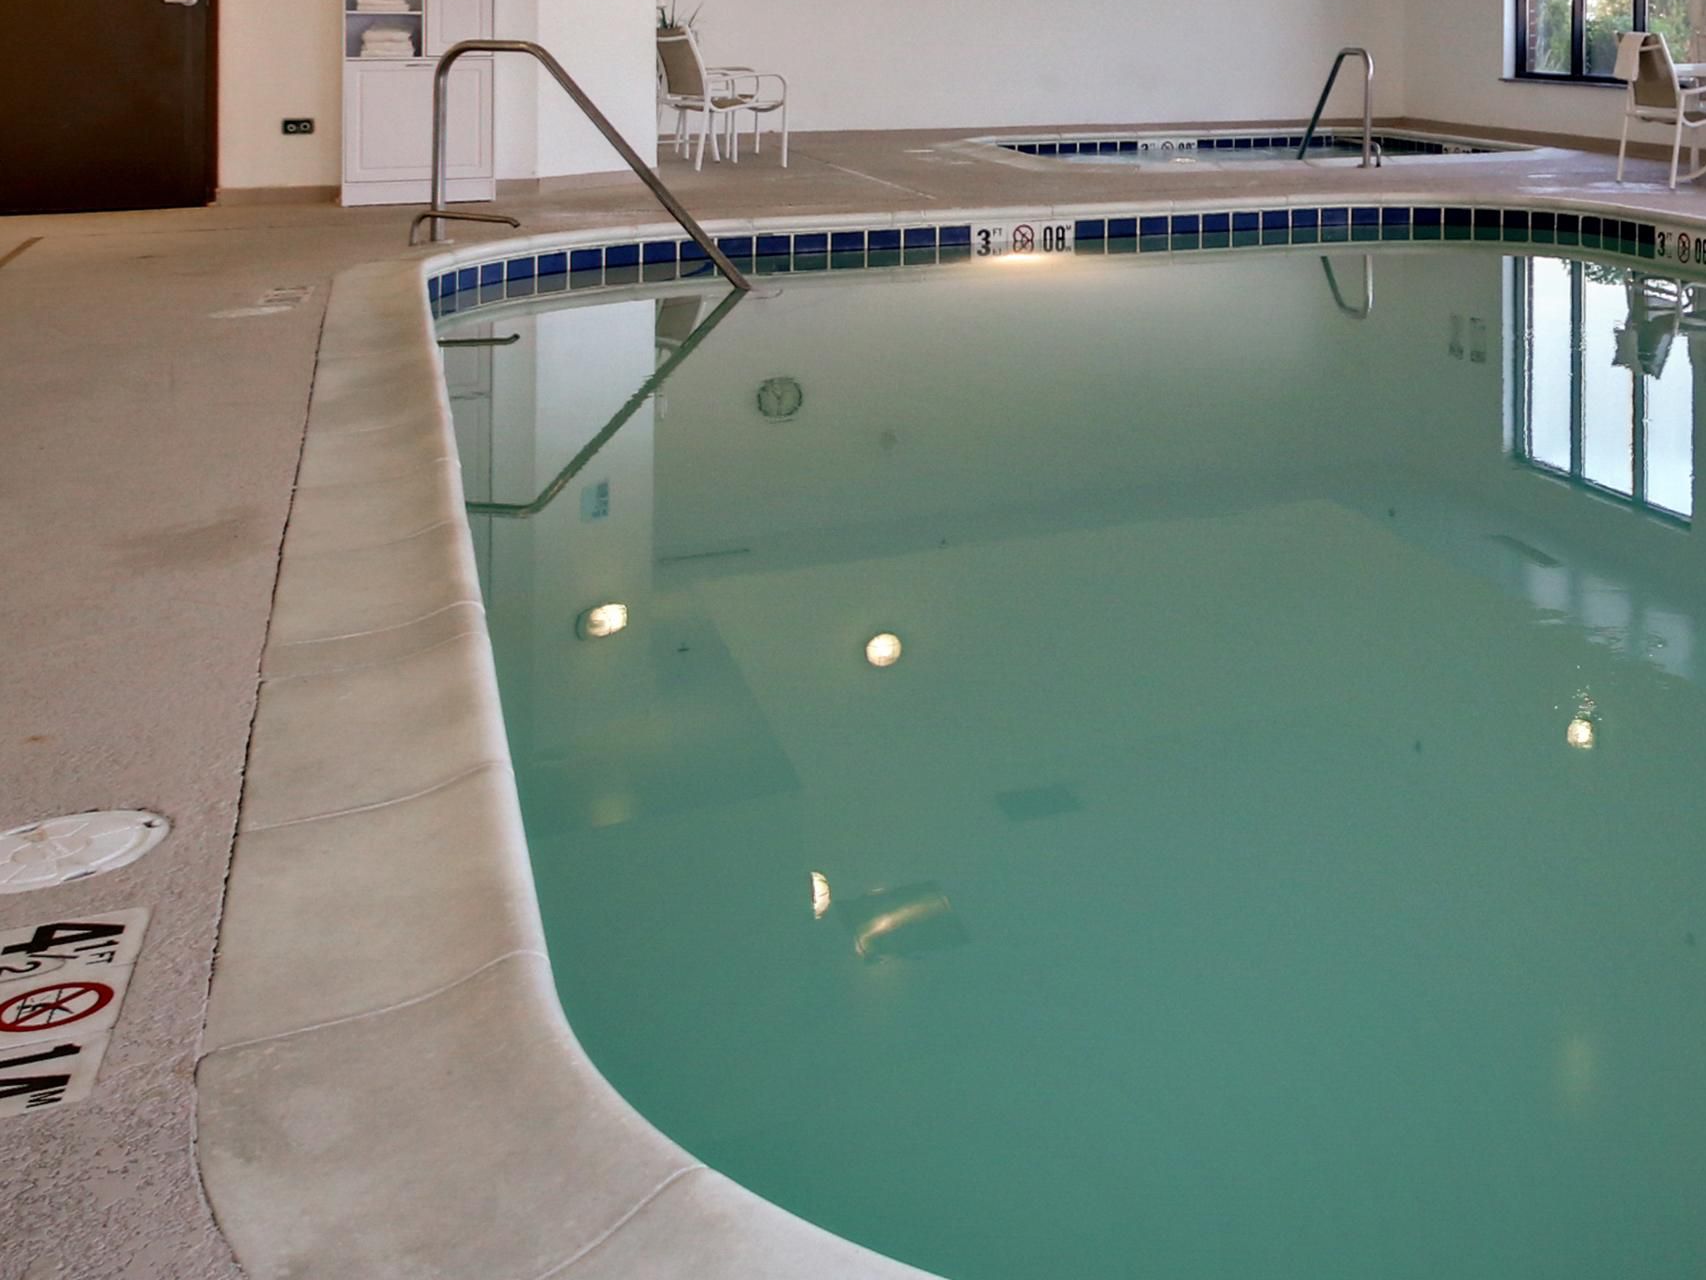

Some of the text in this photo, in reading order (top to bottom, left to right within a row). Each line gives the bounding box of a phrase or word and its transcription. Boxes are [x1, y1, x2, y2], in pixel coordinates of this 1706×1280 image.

[992, 228, 1002, 237] FT
[1, 922, 125, 955] 4
[86, 950, 116, 966] FT
[26, 1088, 66, 1109] M
